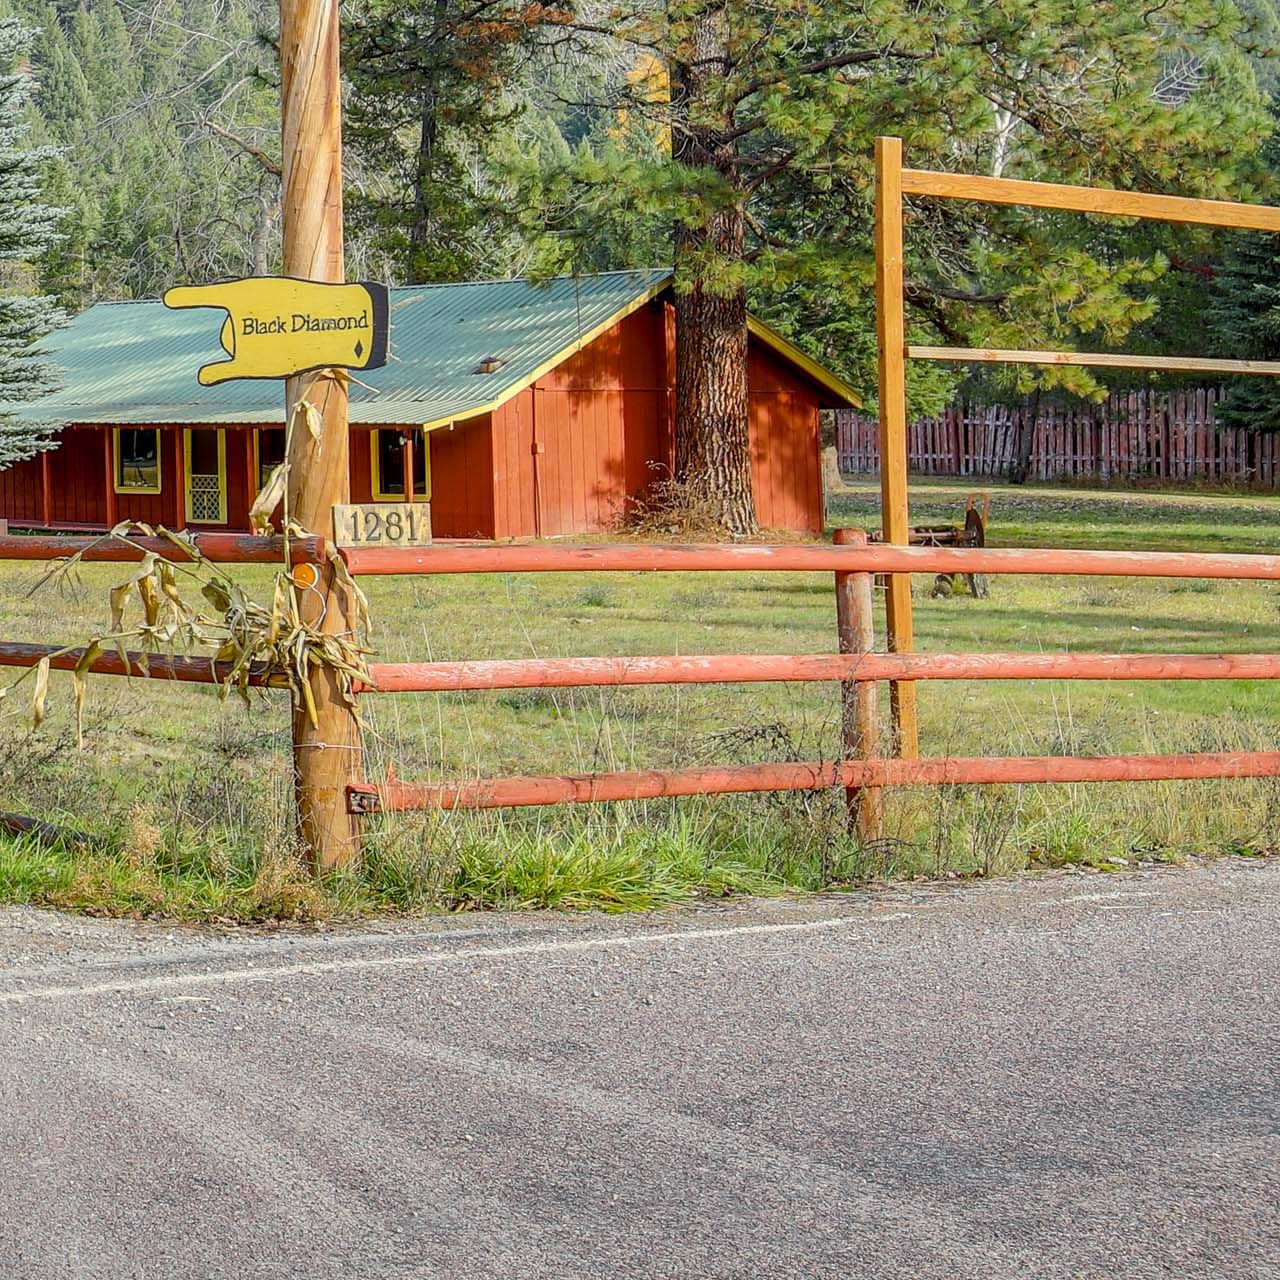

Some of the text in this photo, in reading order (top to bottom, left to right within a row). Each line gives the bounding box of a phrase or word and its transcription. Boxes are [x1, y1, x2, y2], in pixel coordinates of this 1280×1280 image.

[242, 309, 369, 336] Black Diamond
[350, 510, 419, 542] 1281
